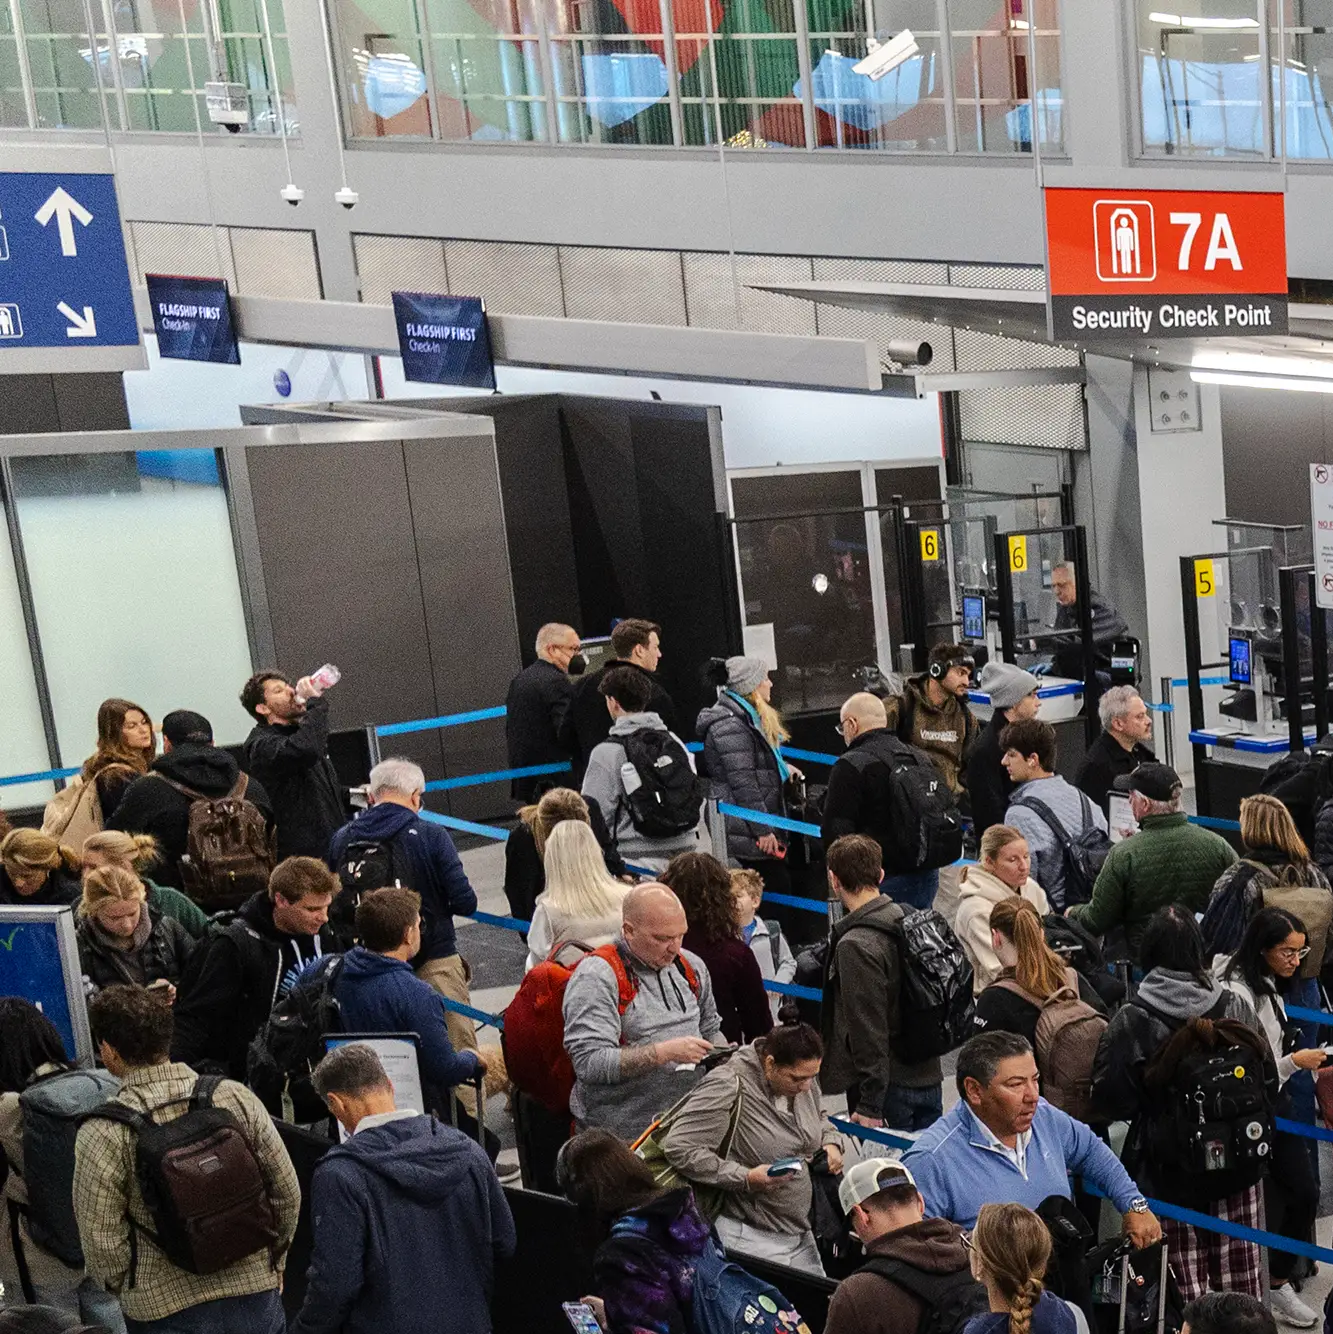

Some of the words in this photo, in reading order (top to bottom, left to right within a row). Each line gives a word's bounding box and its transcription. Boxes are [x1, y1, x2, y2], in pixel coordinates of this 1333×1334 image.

[1169, 212, 1243, 271] 7A
[160, 302, 198, 318] FLAGSHIP
[199, 306, 220, 320] FIRST
[1072, 306, 1152, 334] Security
[1158, 304, 1219, 328] Check
[1224, 304, 1272, 326] Point
[406, 323, 450, 340] FLAGSHIP
[451, 327, 476, 342] FIRST
[1318, 520, 1328, 529] NO
[924, 535, 935, 556] 6
[1013, 546, 1024, 568] 6
[1199, 571, 1212, 594] 5
